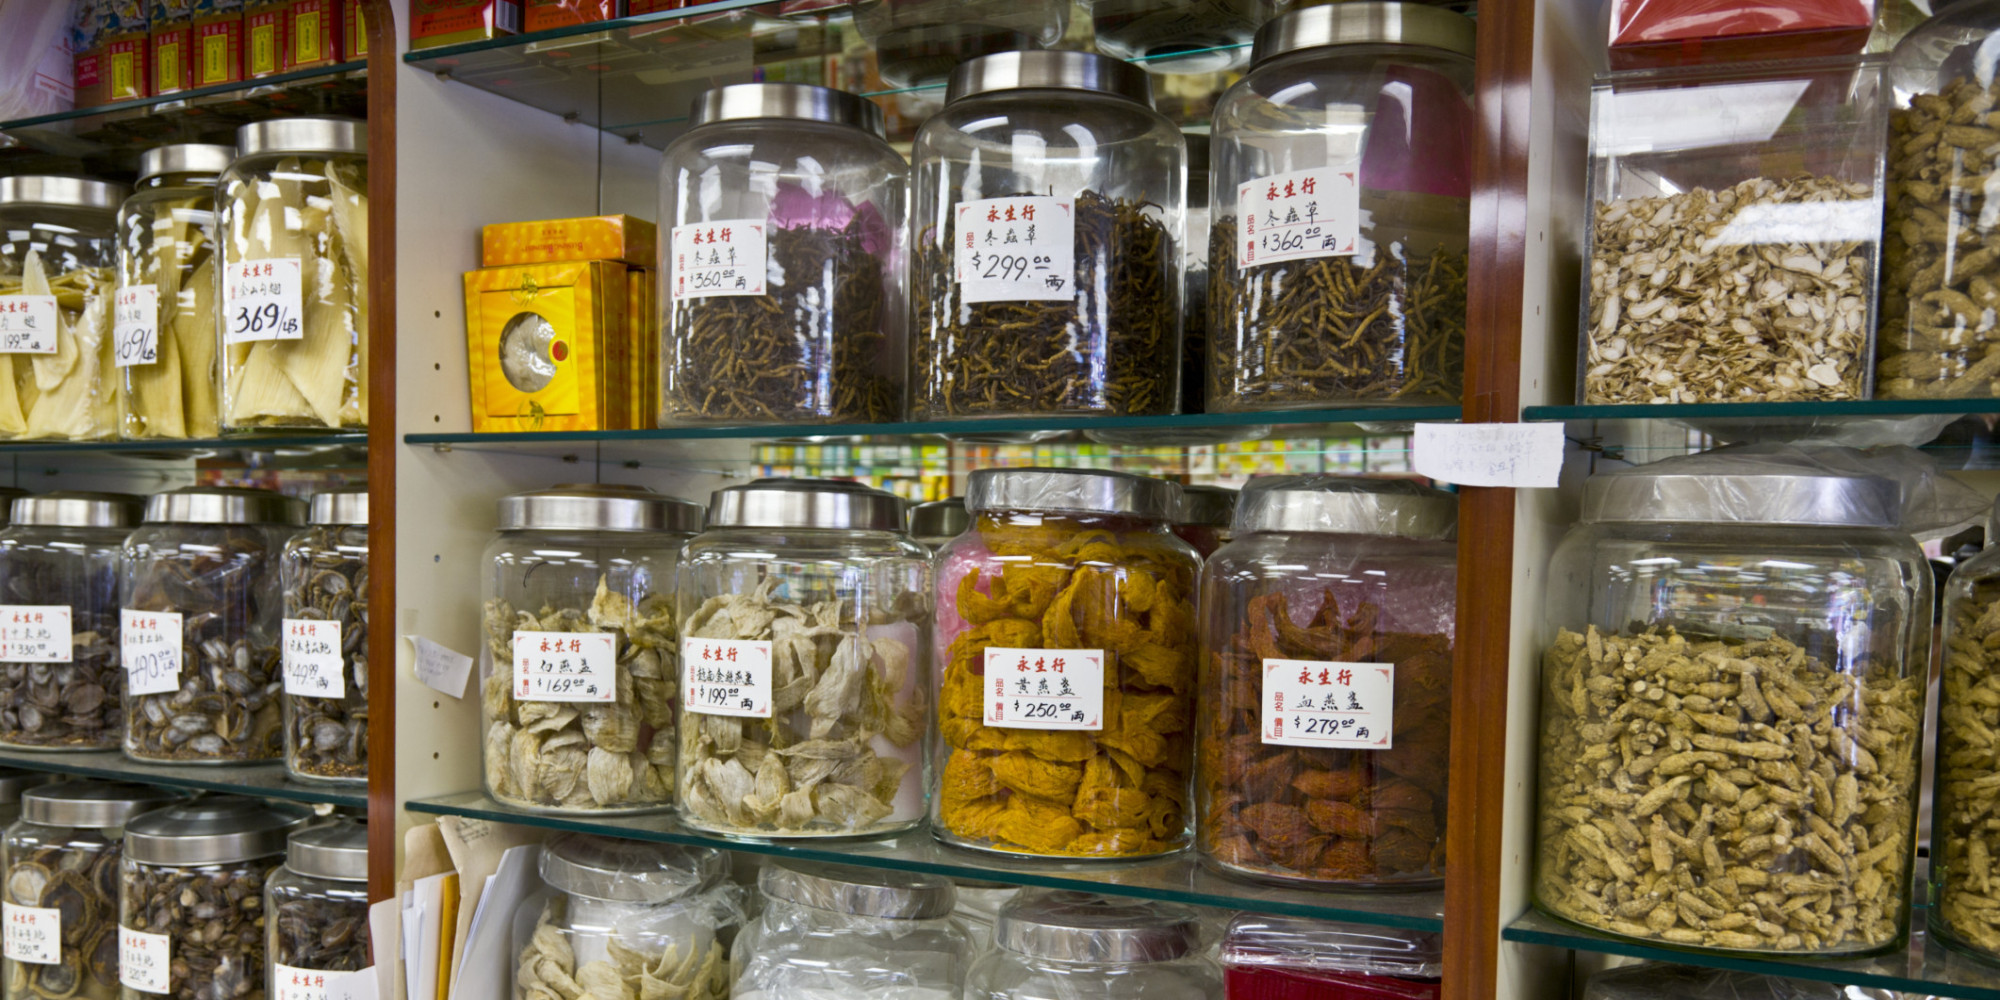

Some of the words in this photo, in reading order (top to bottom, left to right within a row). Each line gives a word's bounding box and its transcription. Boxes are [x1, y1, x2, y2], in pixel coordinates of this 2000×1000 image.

[1267, 177, 1316, 201] 永生行
[987, 205, 1036, 222] 永生行
[693, 227, 732, 245] 永生行
[242, 264, 273, 278] 永生行
[13, 611, 43, 624] 永生行
[132, 616, 157, 630] 永生行
[291, 624, 315, 637] 永生行
[540, 638, 581, 653] 永生行
[702, 644, 738, 662] 永生行
[1017, 656, 1066, 673] 永生行
[1298, 666, 1353, 686] 永生行
[292, 973, 324, 988] 永生行
